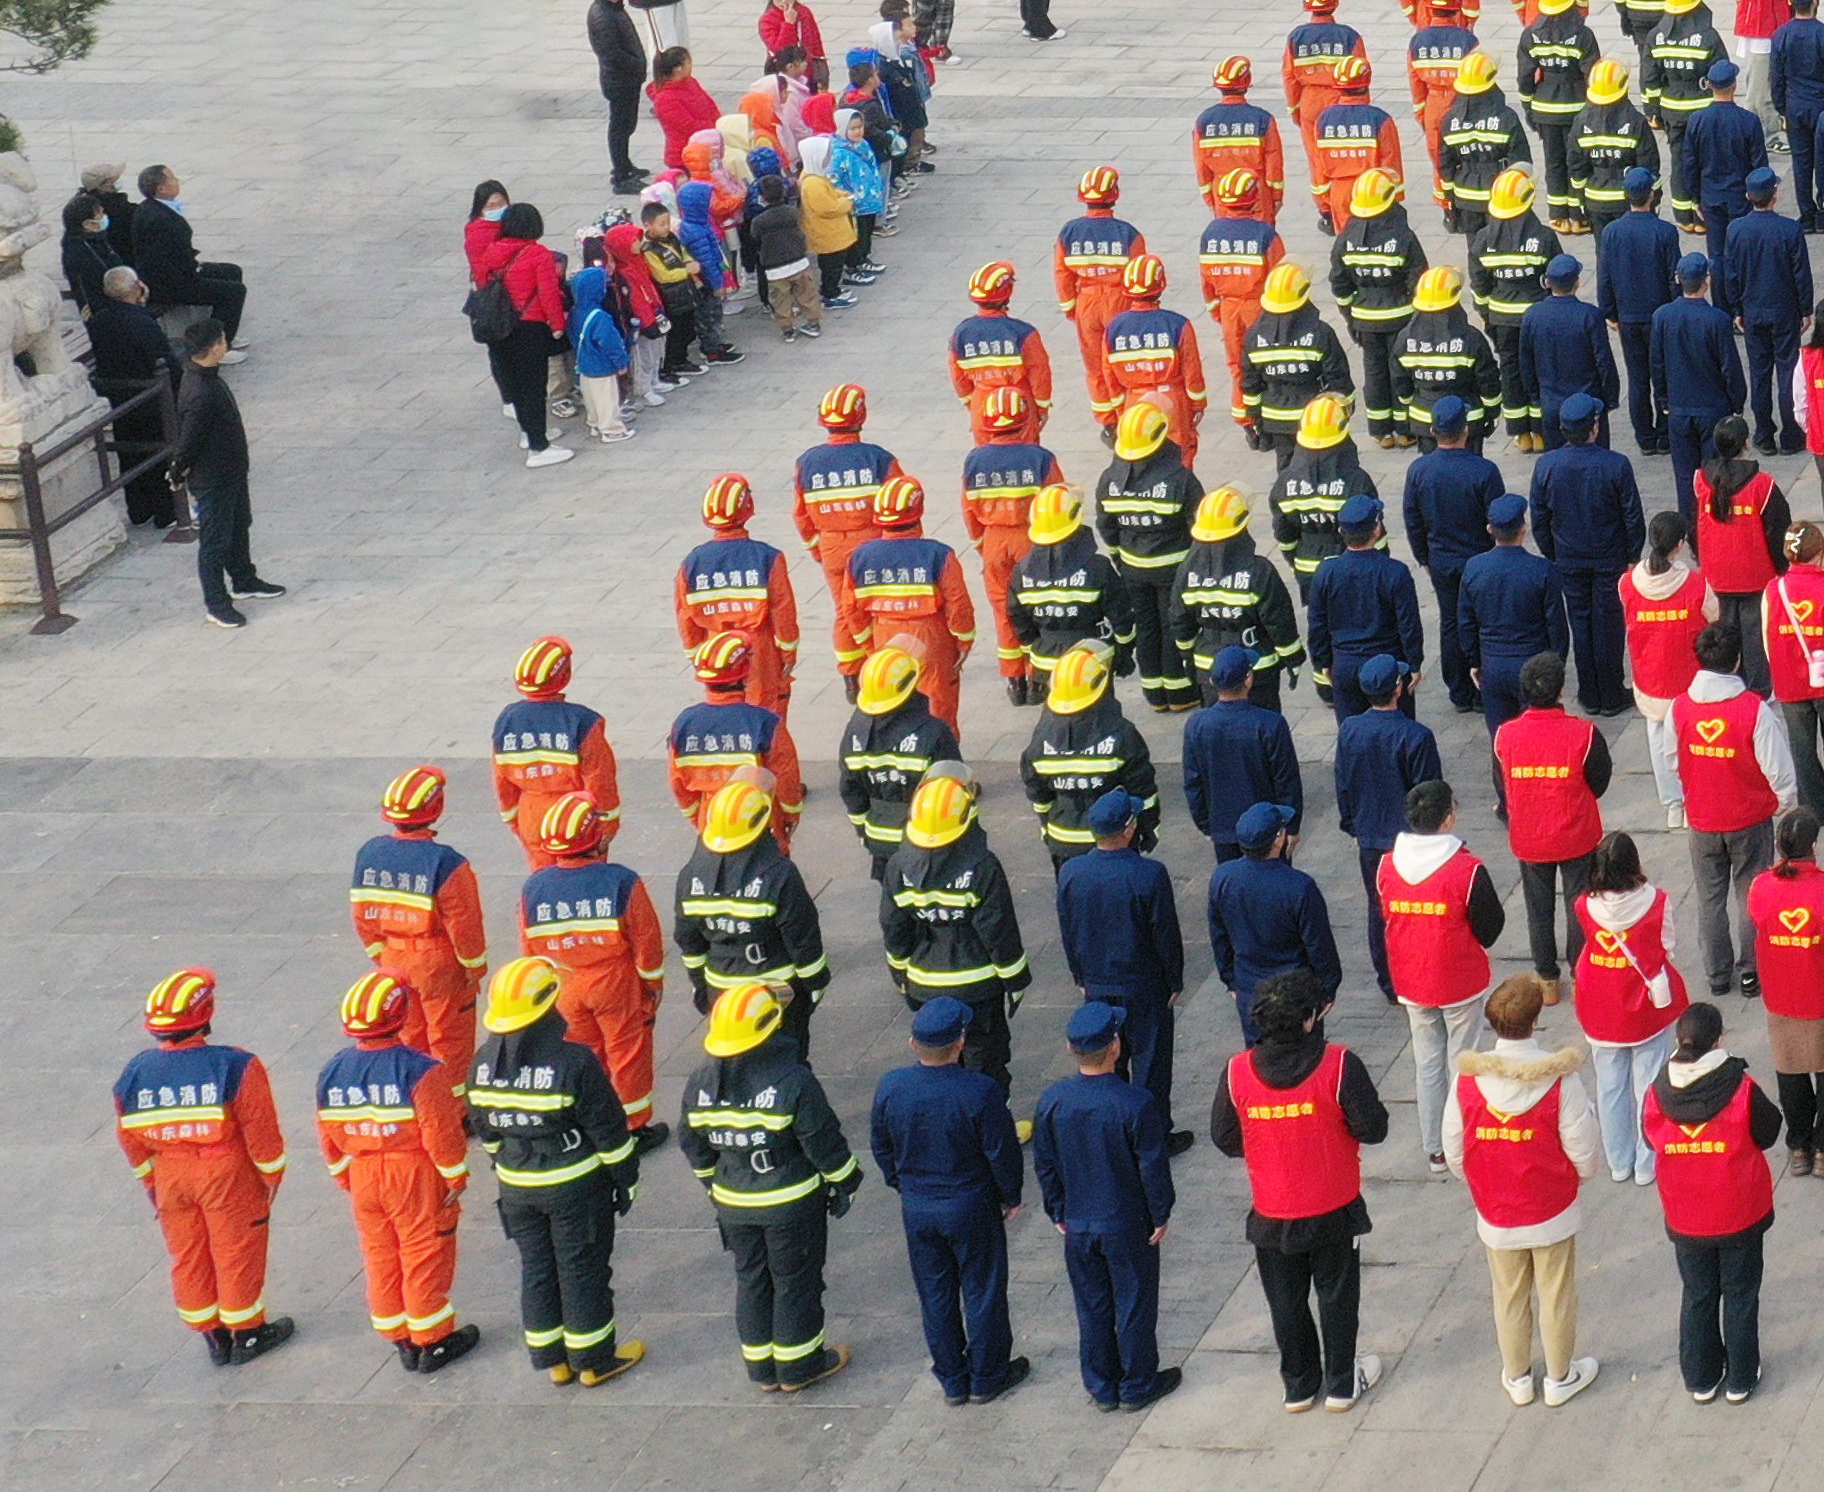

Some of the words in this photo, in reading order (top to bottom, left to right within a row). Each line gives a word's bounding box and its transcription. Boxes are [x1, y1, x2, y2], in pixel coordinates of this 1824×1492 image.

[1299, 44, 1343, 56] 应急消防
[1418, 46, 1462, 59] 应急消防
[1205, 123, 1254, 137] 应急消防
[1324, 124, 1372, 137] 应急消防
[1071, 240, 1122, 256] 应急消防
[1206, 239, 1259, 253] 应急消防
[964, 341, 1015, 356] 应急消防
[1115, 333, 1170, 350] 应急消防
[811, 469, 873, 489] 应急消防
[975, 469, 1034, 485] 应急消防
[695, 573, 759, 589] 应急消防
[864, 568, 927, 586] 应急消防
[1636, 610, 1688, 621] 消防志愿者
[503, 733, 569, 751] 应急消防
[685, 734, 752, 752] 应急消防
[1689, 744, 1734, 758] 消防志愿者
[1511, 766, 1569, 779] 消防志愿者
[362, 868, 428, 893] 应急消防
[536, 898, 612, 922] 应急消防
[1389, 901, 1447, 915] 消防志愿者
[1769, 935, 1819, 948] 消防志愿者
[475, 1064, 555, 1089] 应消防
[137, 1083, 218, 1110] 应急消防
[327, 1085, 402, 1108] 应急消防
[1247, 1103, 1313, 1119] 消防志愿者
[1475, 1127, 1533, 1142] 消防志愿者
[1665, 1142, 1726, 1154] 消防志愿者
